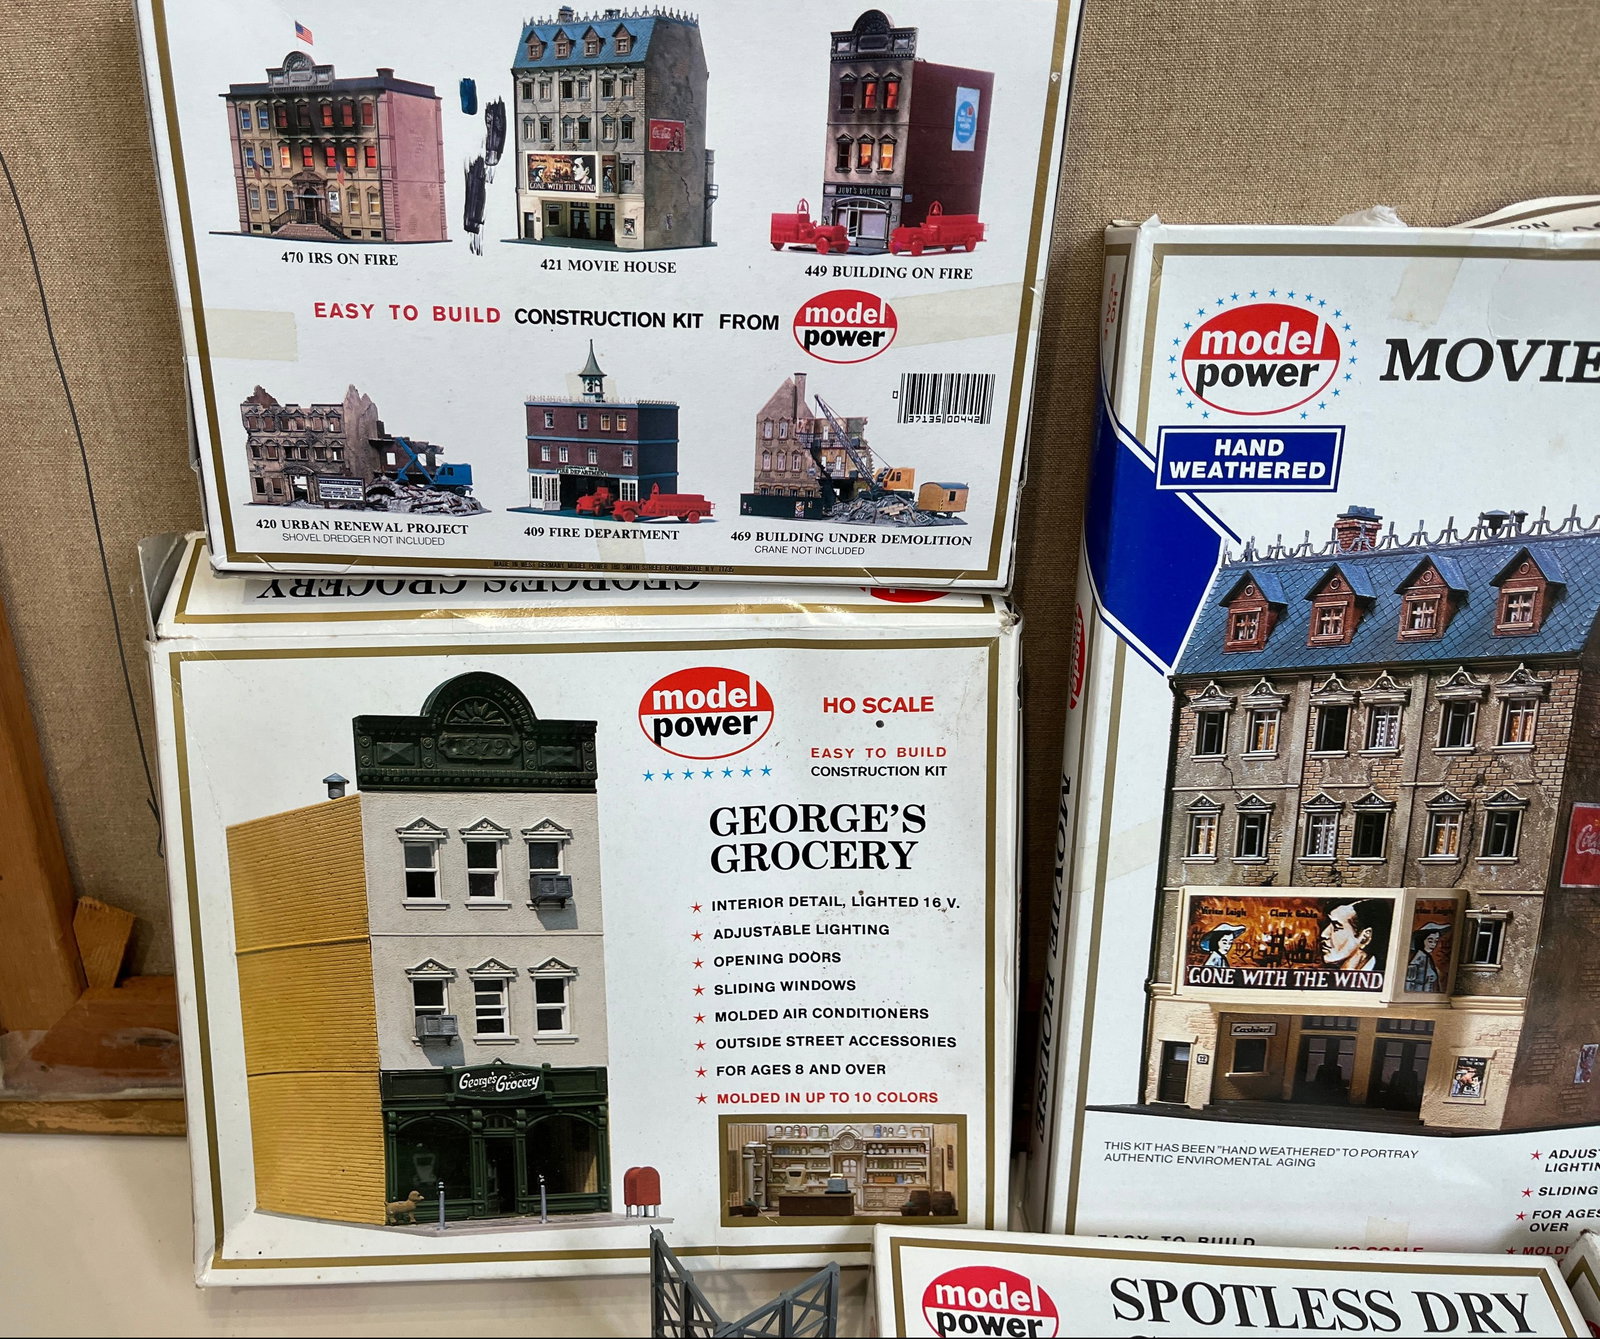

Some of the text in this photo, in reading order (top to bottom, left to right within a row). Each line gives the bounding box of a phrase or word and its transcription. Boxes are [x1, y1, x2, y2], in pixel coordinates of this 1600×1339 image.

[281, 251, 399, 266] 470 IRS ON FIRE
[540, 259, 677, 274] 421 MOVIE HOUSE
[805, 265, 973, 280] 449 BUILDING ON FIRE
[314, 302, 779, 331] EASY TO BUILD CONSTRUCTION KIT FROM
[805, 299, 885, 325] model
[804, 328, 885, 351] power
[1200, 317, 1327, 356] model
[1380, 338, 1600, 383] MOVIE
[1195, 363, 1319, 397] power
[908, 415, 980, 423] 37135 00442
[1214, 438, 1285, 456] HAND
[1169, 461, 1326, 479] WEATHERED
[256, 519, 469, 535] 420 URBAN RENEWAL PROJECT
[524, 526, 679, 541] 409 FIRE DEPARTMENT
[282, 532, 445, 546] SHOVEL DREDGER NOT INCLUDED
[731, 530, 973, 546] 469 BUILDING UNDER DEMOLITION
[754, 545, 865, 555] CRANE NOT INCLUDED
[652, 676, 757, 711] model
[823, 696, 935, 713] HO SCALE
[653, 714, 758, 747] power
[811, 746, 947, 759] EASY TO BUILD
[810, 765, 948, 777] CONSTRUCTION KIT
[709, 803, 927, 837] GEORGE'S
[710, 840, 919, 874] GROCERY
[711, 895, 960, 911] INTERIOR DETAIL, LIGHTED 16 V.
[1269, 908, 1293, 918] Clark
[713, 924, 890, 940] ADJUSTABLE LIGHTING
[714, 951, 842, 968] OPENING DOORS
[1189, 967, 1383, 989] GONE WITH THE WIND
[714, 980, 856, 996] SLIDING WINDOWS
[715, 1007, 929, 1023] MOLDED AIR CONDITIONERS
[715, 1035, 957, 1050] OUTSIDE STREET ACCESSORIES
[1035, 970, 1056, 1144] HOUSE
[716, 1063, 887, 1077] FOR AGES 8 AND OVER
[458, 1071, 540, 1093] George's Grocery
[717, 1092, 939, 1104] MOLDED IN UP TO 10 COLORS
[1104, 1141, 1131, 1151] THIS
[1134, 1142, 1153, 1151] KIT
[1154, 1143, 1179, 1152] HAS
[1181, 1144, 1215, 1153] BEEN
[1342, 1148, 1358, 1157] TO
[1360, 1148, 1419, 1159] PORTRAY
[1548, 1149, 1600, 1159] ADJUS
[1104, 1153, 1316, 1167] AUTHENTIC ENVIROMENTAL AGING
[1538, 1186, 1598, 1196] SLIDING
[1532, 1210, 1562, 1219] FOR
[1529, 1222, 1569, 1232] OVER
[935, 1278, 1042, 1312] model
[1110, 1276, 1537, 1334] SPOTLESS DRY
[936, 1311, 1043, 1338] power
